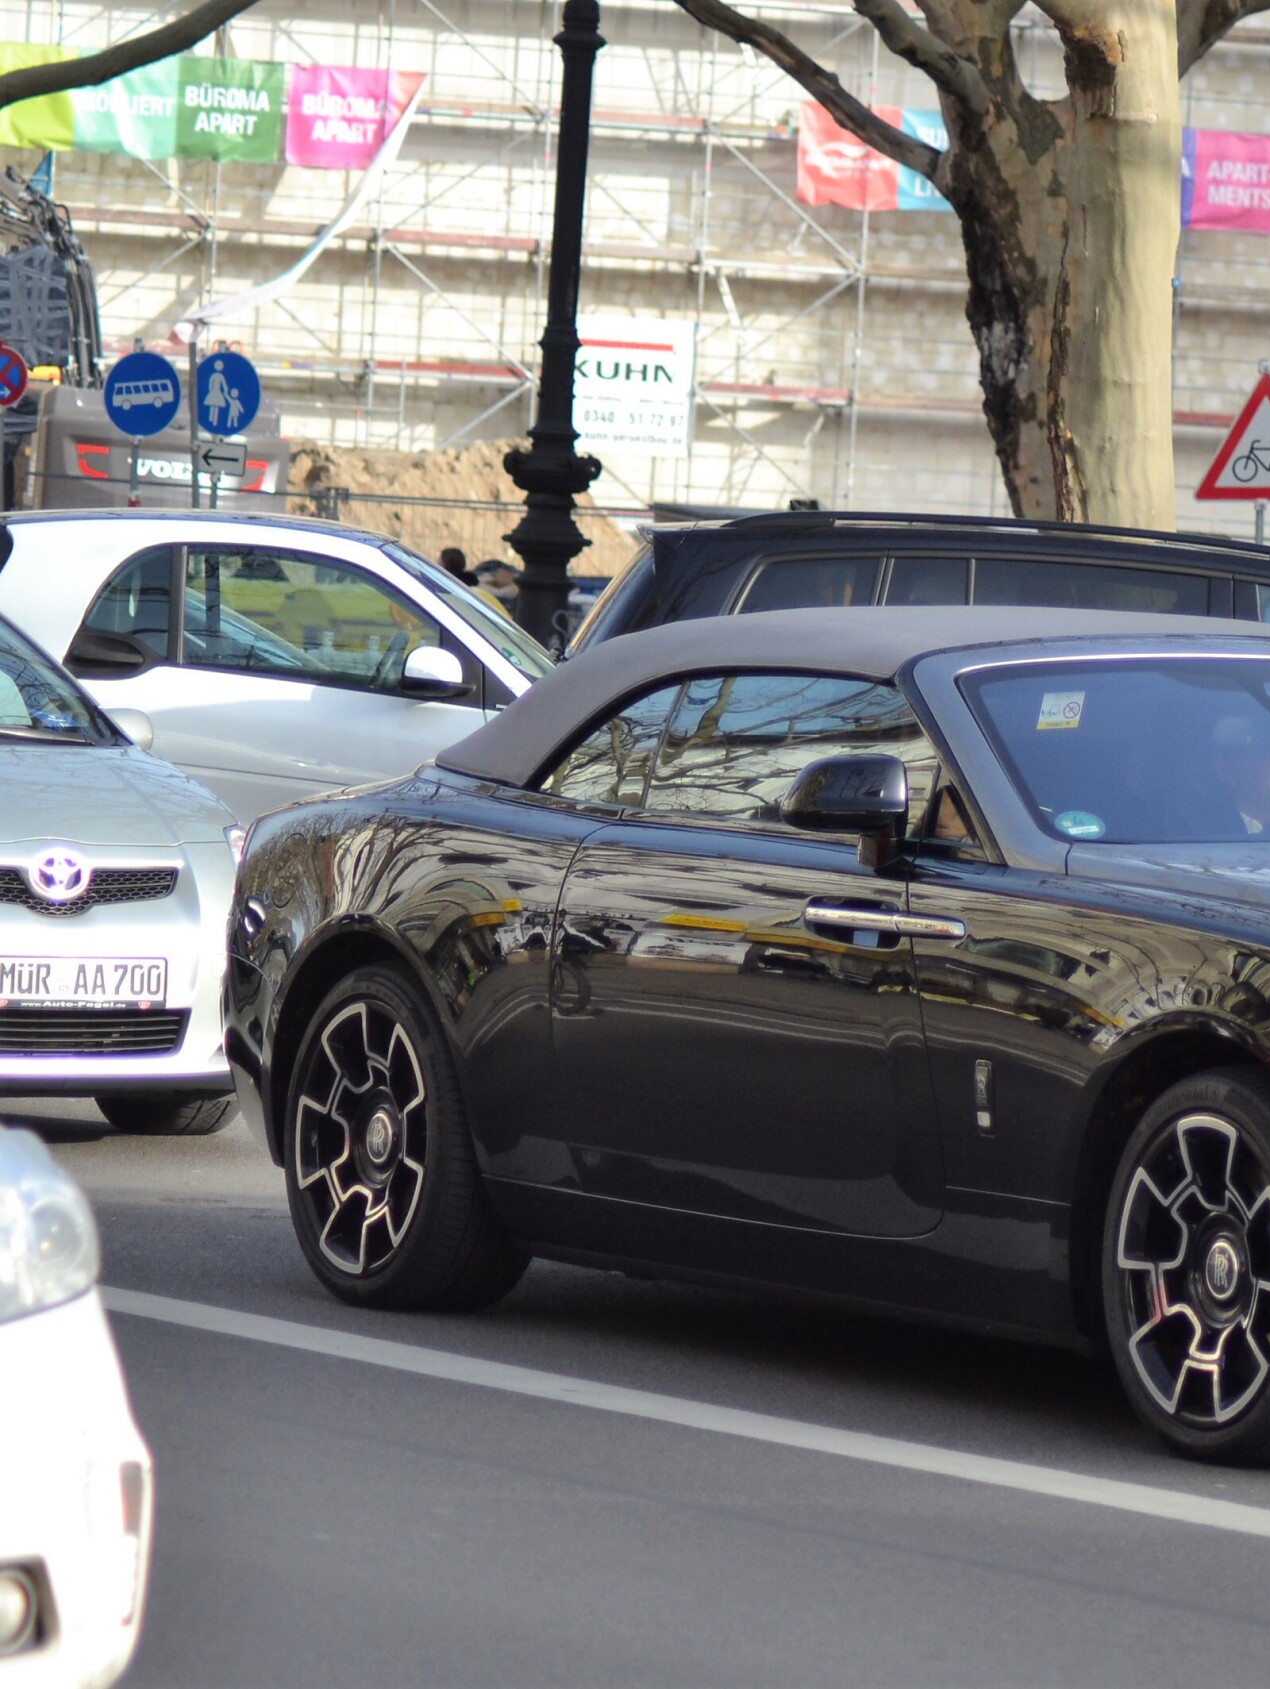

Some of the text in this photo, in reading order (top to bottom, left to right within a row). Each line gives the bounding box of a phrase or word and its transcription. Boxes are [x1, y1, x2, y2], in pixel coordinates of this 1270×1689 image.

[184, 84, 270, 112] BÜROMA
[194, 112, 257, 136] APART
[310, 118, 377, 144] APART
[575, 360, 673, 383] KUHN
[73, 964, 106, 995] AA
[114, 964, 161, 996] 700
